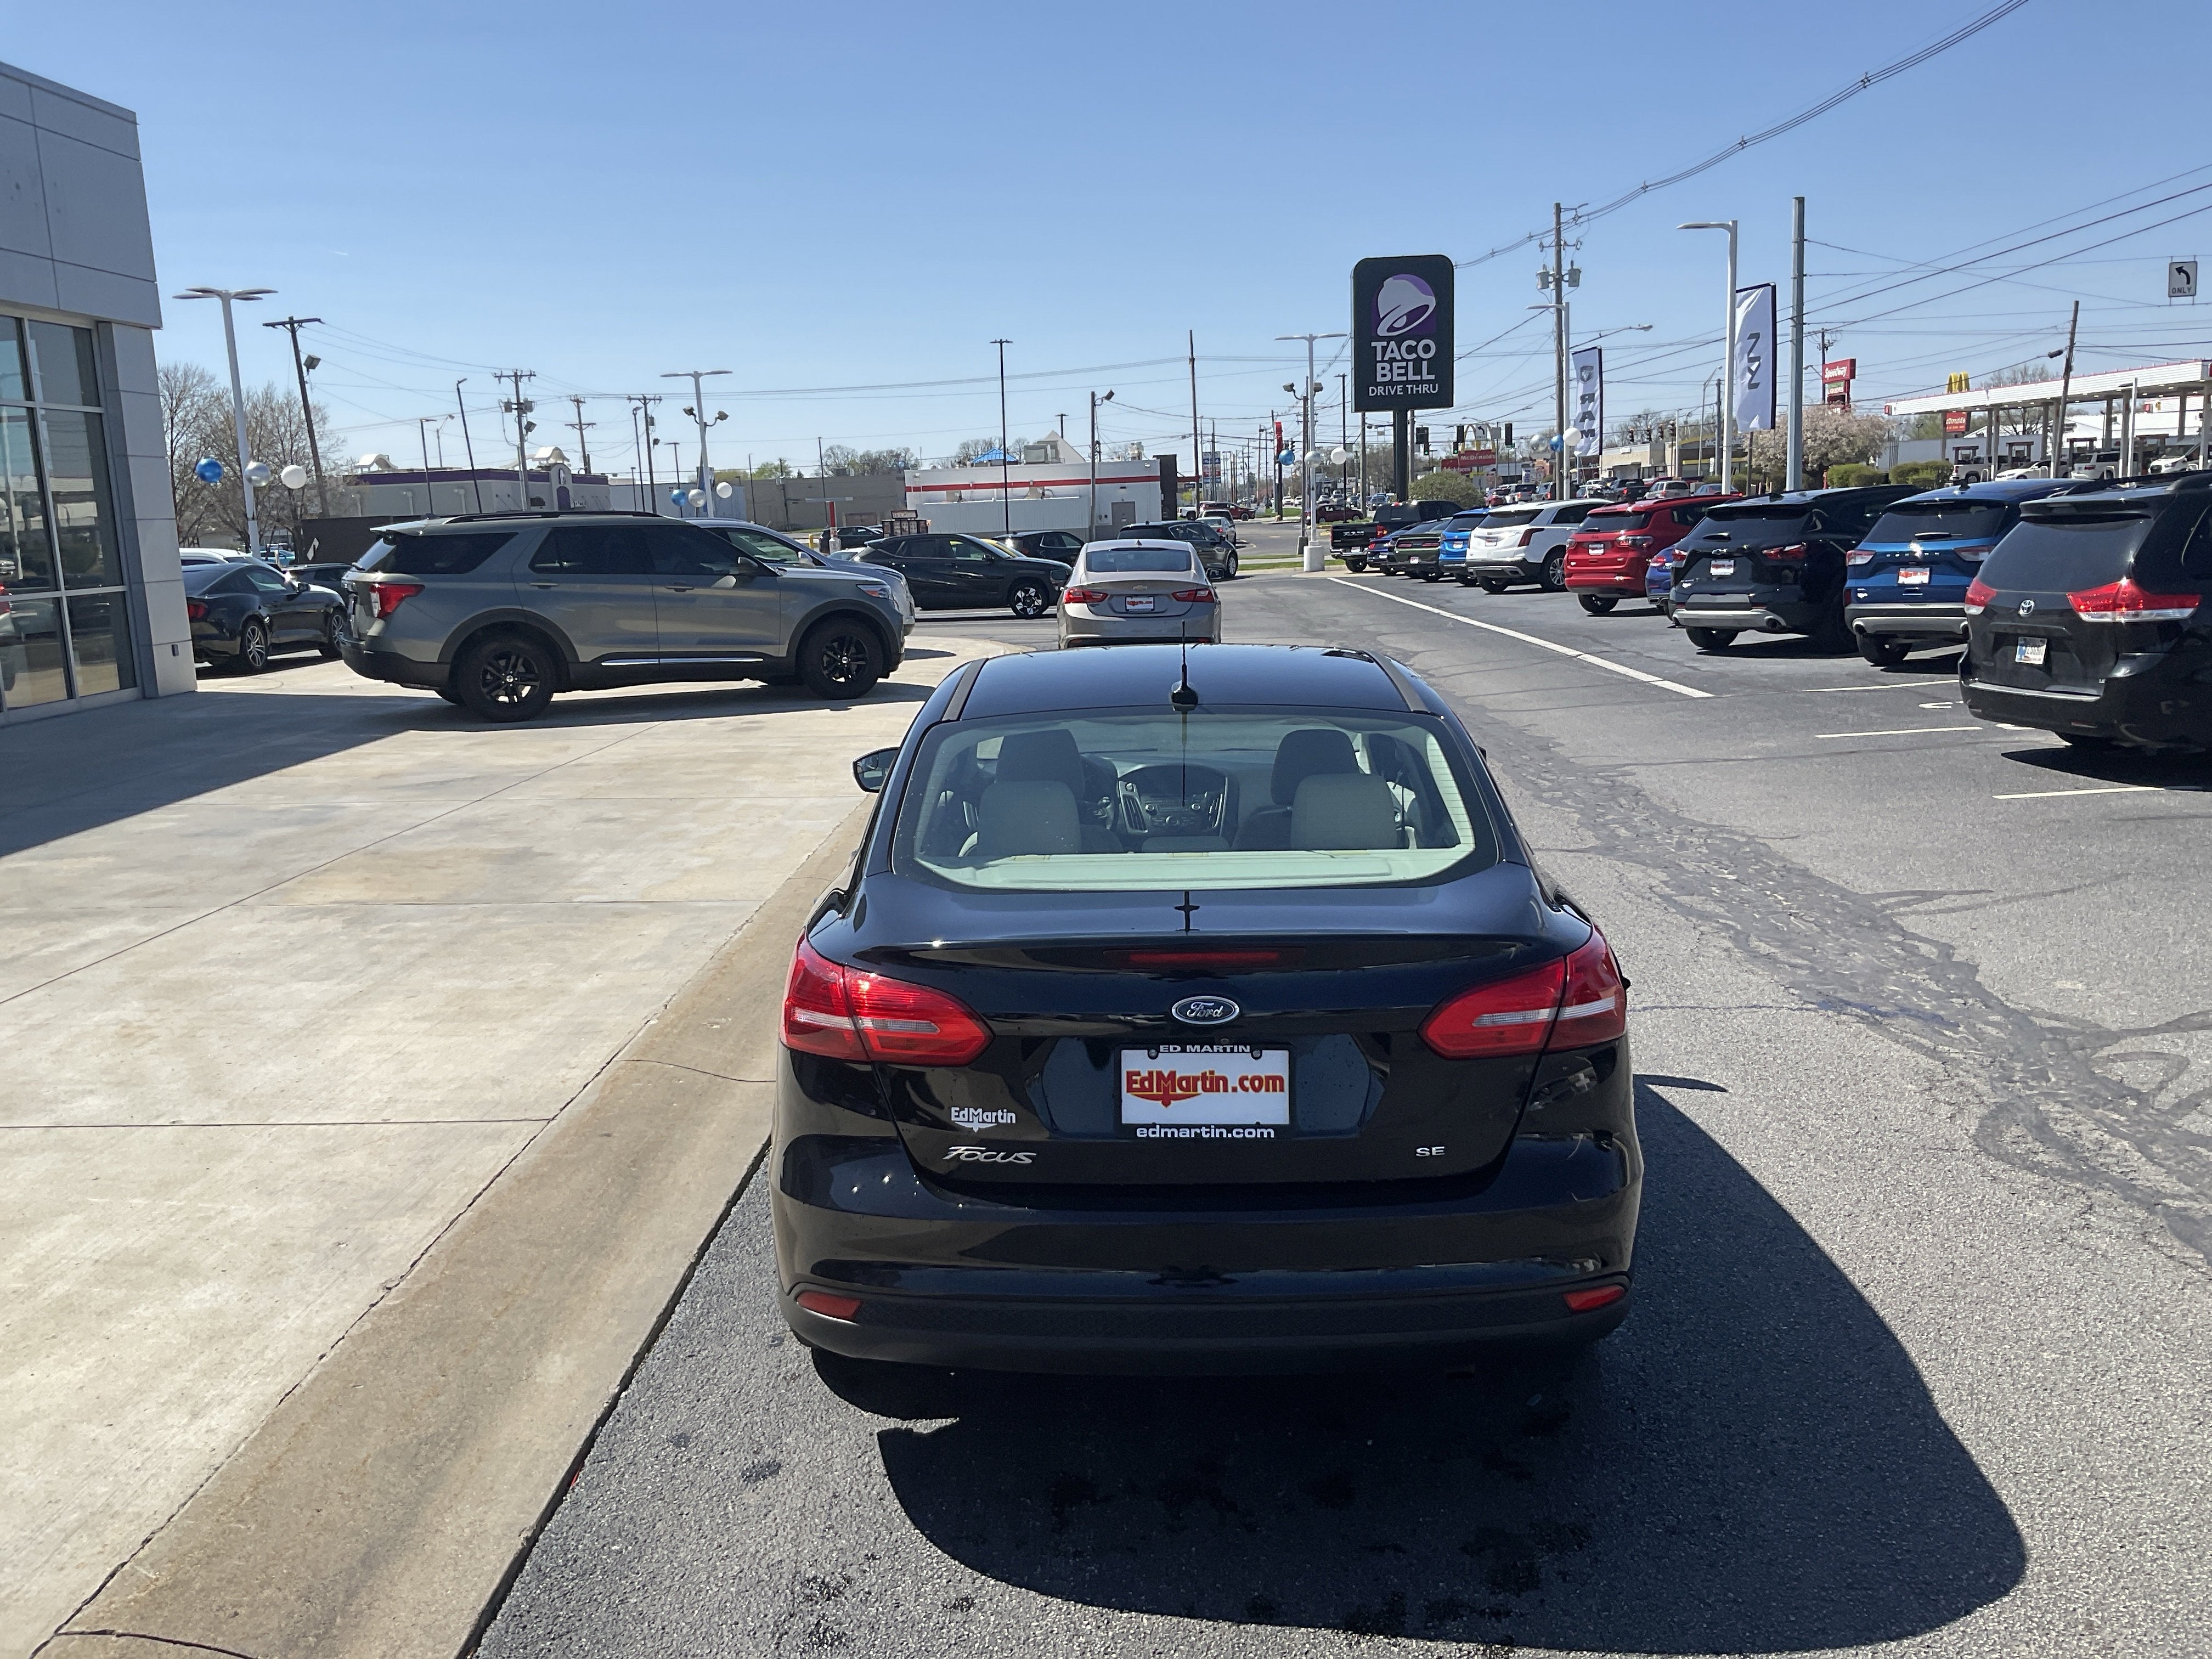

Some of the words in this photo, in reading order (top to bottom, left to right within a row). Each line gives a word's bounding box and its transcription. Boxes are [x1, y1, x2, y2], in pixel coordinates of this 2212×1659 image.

[1371, 339, 1436, 361] TACO
[1376, 360, 1435, 382] BELL
[1825, 365, 1847, 380] Speedway
[1369, 385, 1403, 396] DRIVE
[1406, 383, 1438, 394] THRU
[1187, 1001, 1224, 1018] Ford
[1126, 1070, 1285, 1093] EdMartin.com
[951, 1107, 1016, 1124] EdMartin
[1136, 1125, 1275, 1138] edmartin.com
[1415, 1146, 1446, 1157] SE
